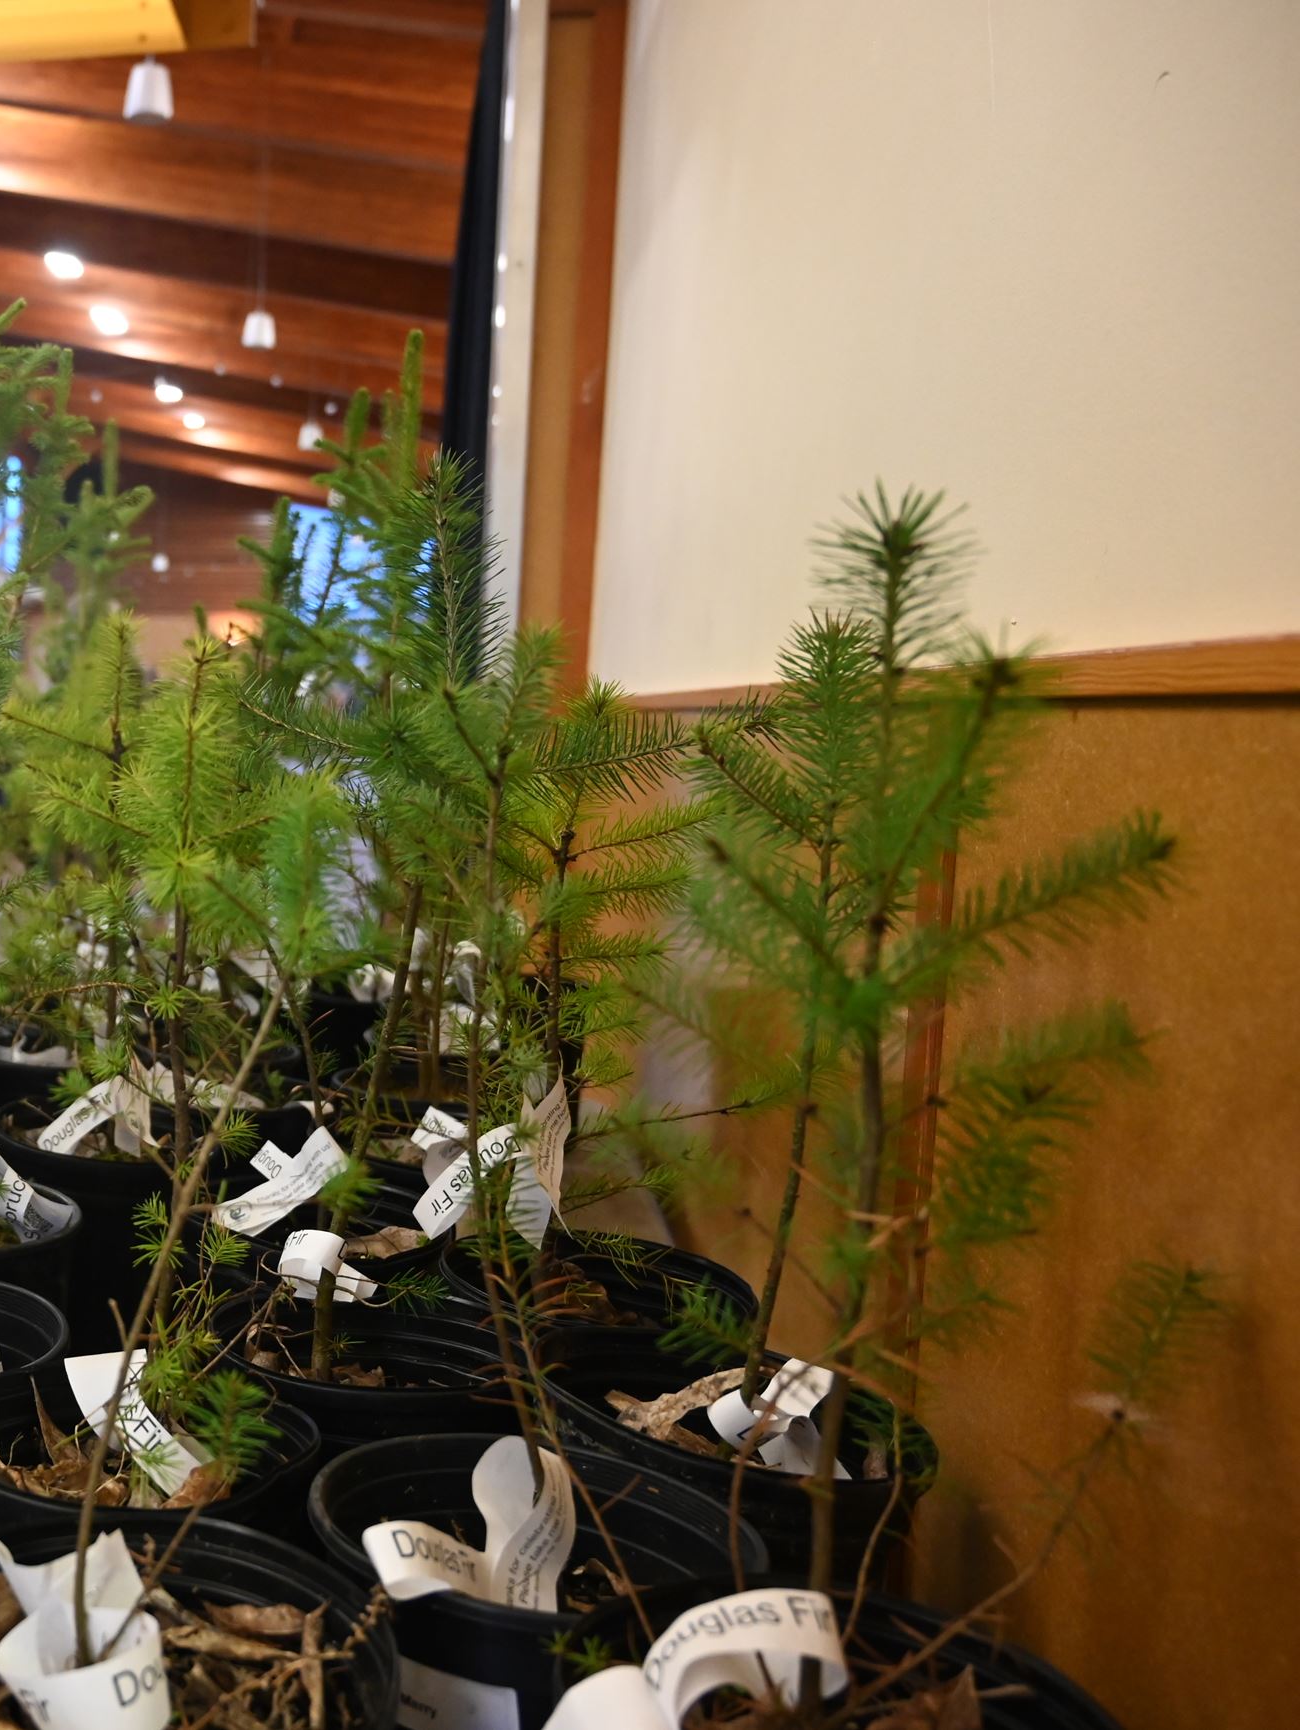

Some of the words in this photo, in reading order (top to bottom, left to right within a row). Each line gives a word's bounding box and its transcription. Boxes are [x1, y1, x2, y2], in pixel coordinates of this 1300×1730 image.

[450, 1135, 521, 1193] Doulas
[431, 1190, 454, 1216] Fir
[645, 1600, 782, 1692] Douglas
[786, 1596, 832, 1632] Fir
